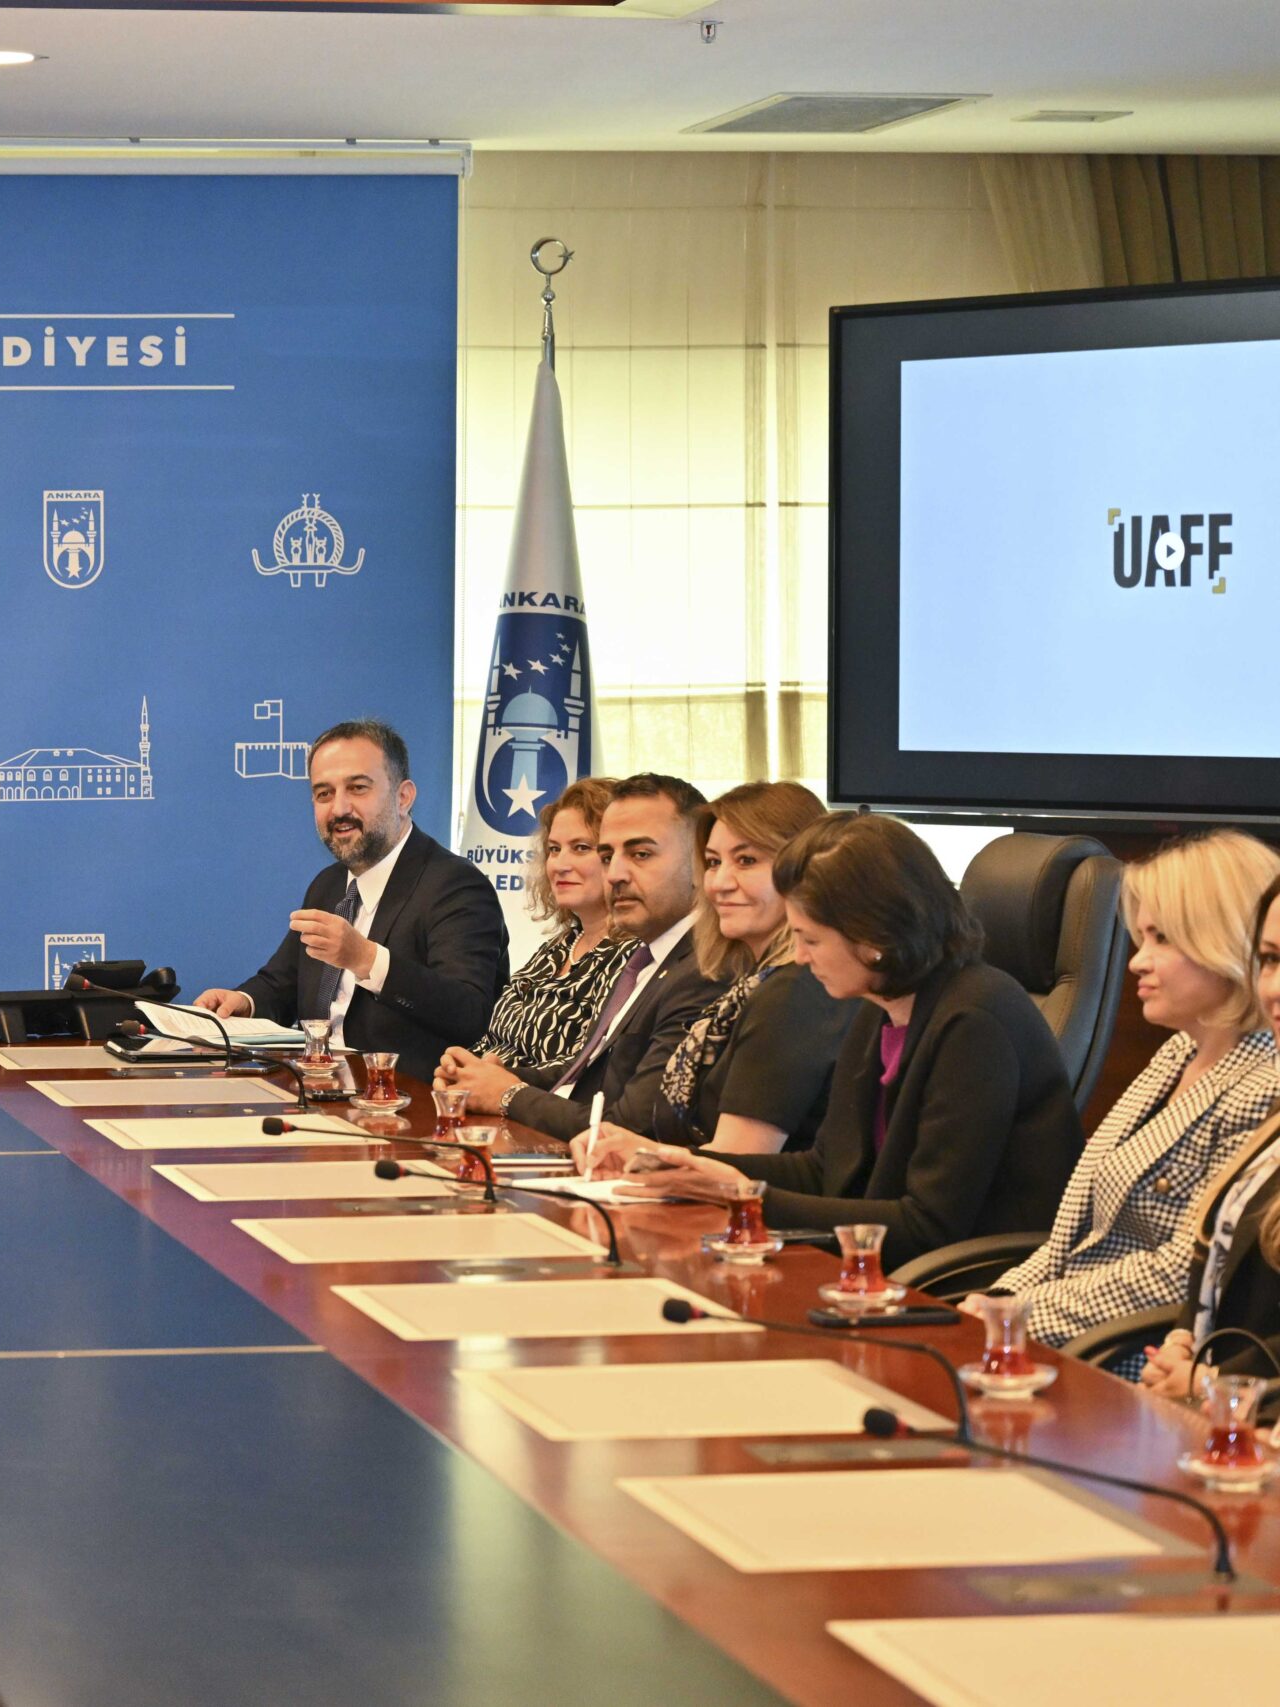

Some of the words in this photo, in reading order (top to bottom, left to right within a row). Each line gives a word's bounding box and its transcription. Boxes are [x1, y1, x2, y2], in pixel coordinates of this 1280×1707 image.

[1113, 513, 1233, 589] UAFF
[499, 591, 586, 615] NKAR
[48, 935, 102, 943] ANKARA
